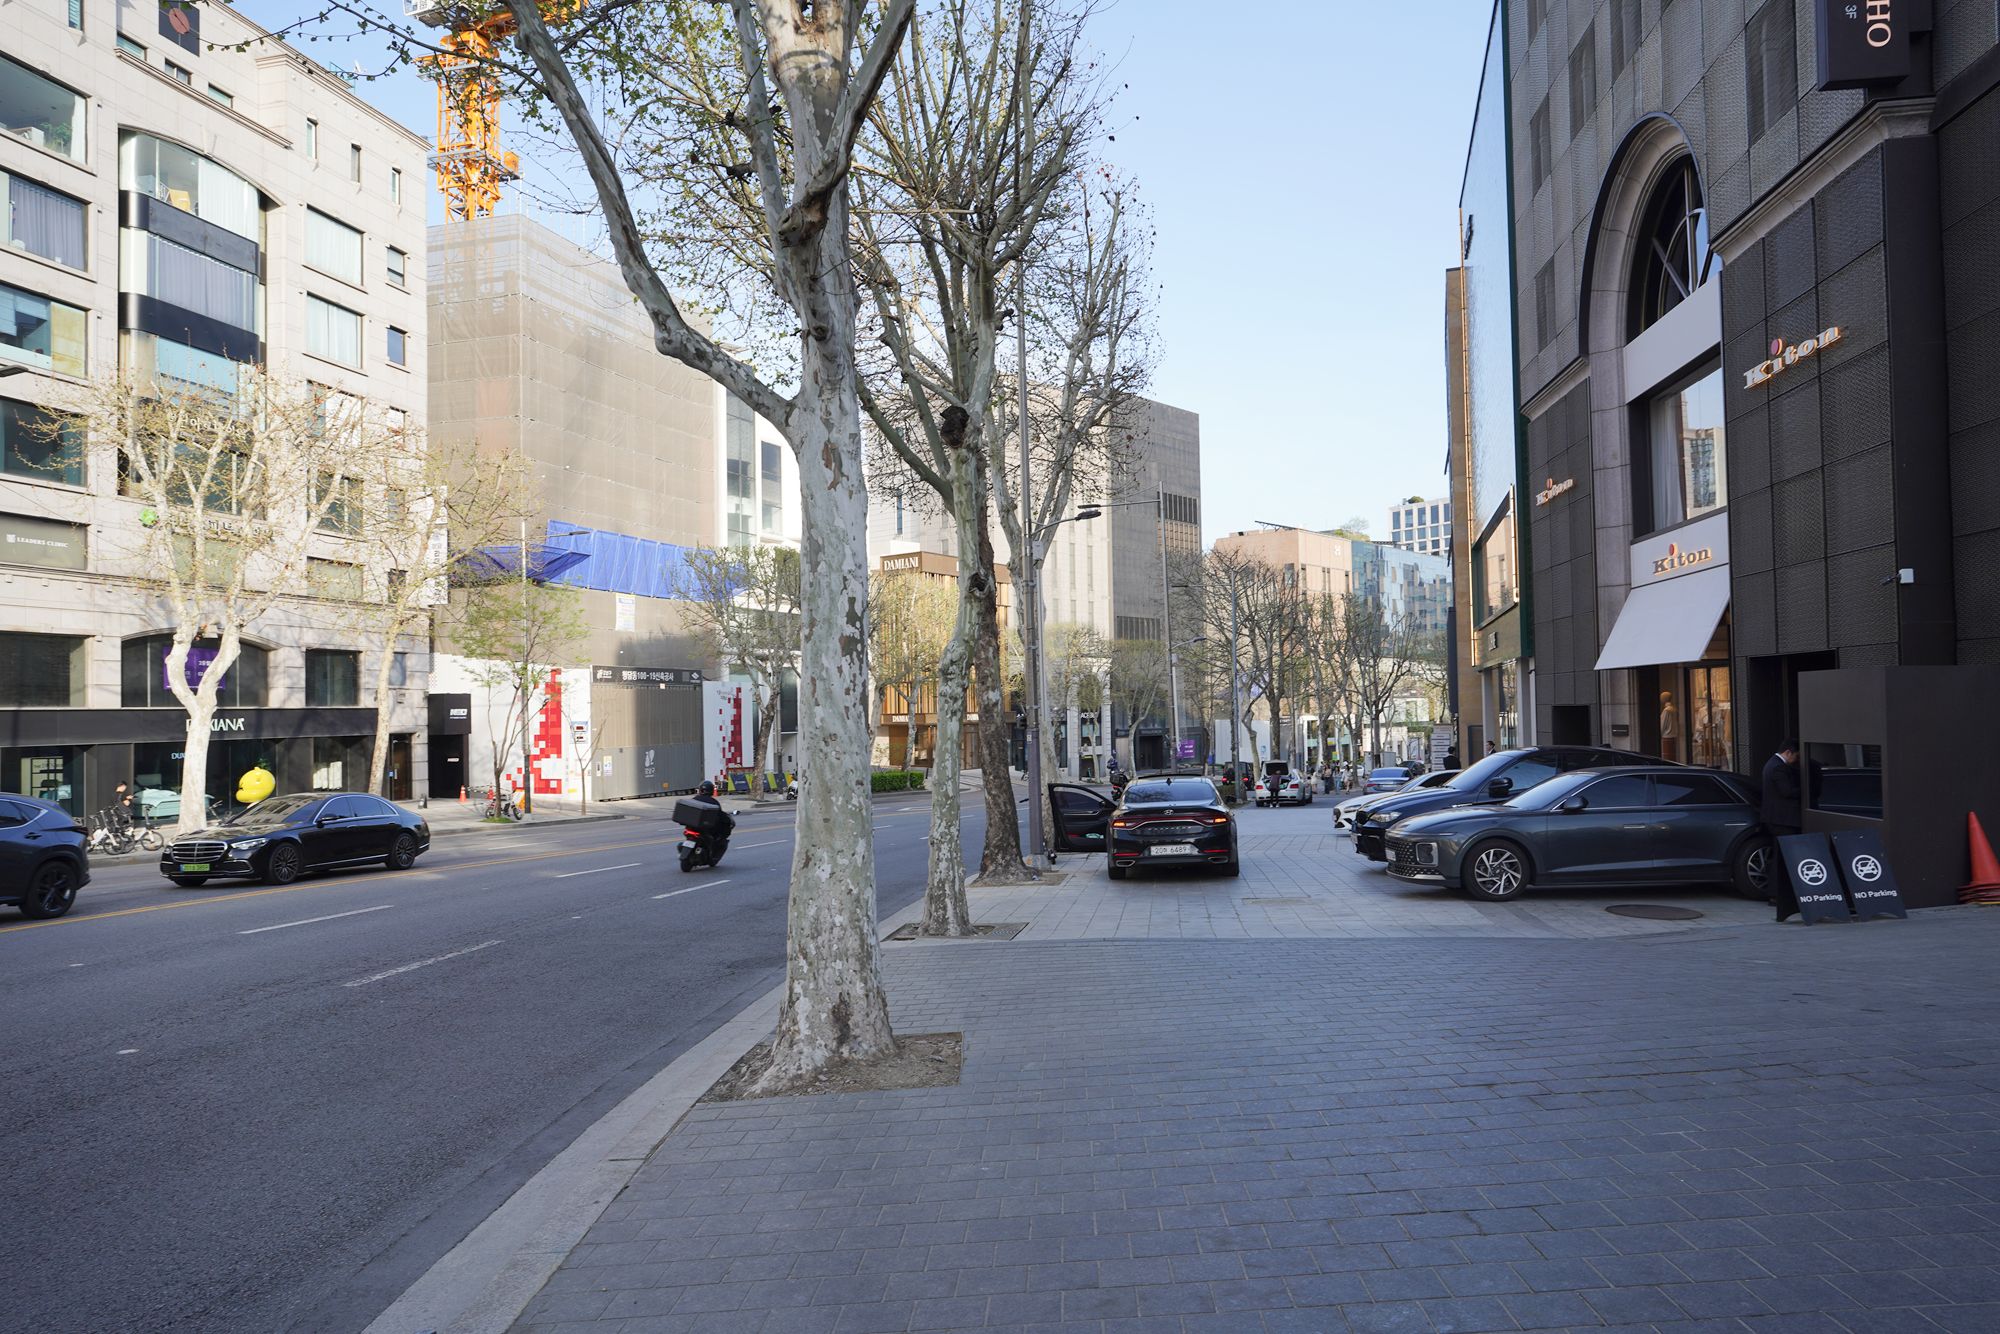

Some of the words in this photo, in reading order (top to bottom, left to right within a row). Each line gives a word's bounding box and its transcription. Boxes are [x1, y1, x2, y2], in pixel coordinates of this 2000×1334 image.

[1743, 326, 1841, 389] Kiton
[1535, 478, 1574, 506] Kiton
[884, 556, 919, 571] DAMIANI
[1652, 543, 1711, 576] Kiton
[1855, 891, 1868, 899] NO
[1868, 889, 1898, 897] Parking
